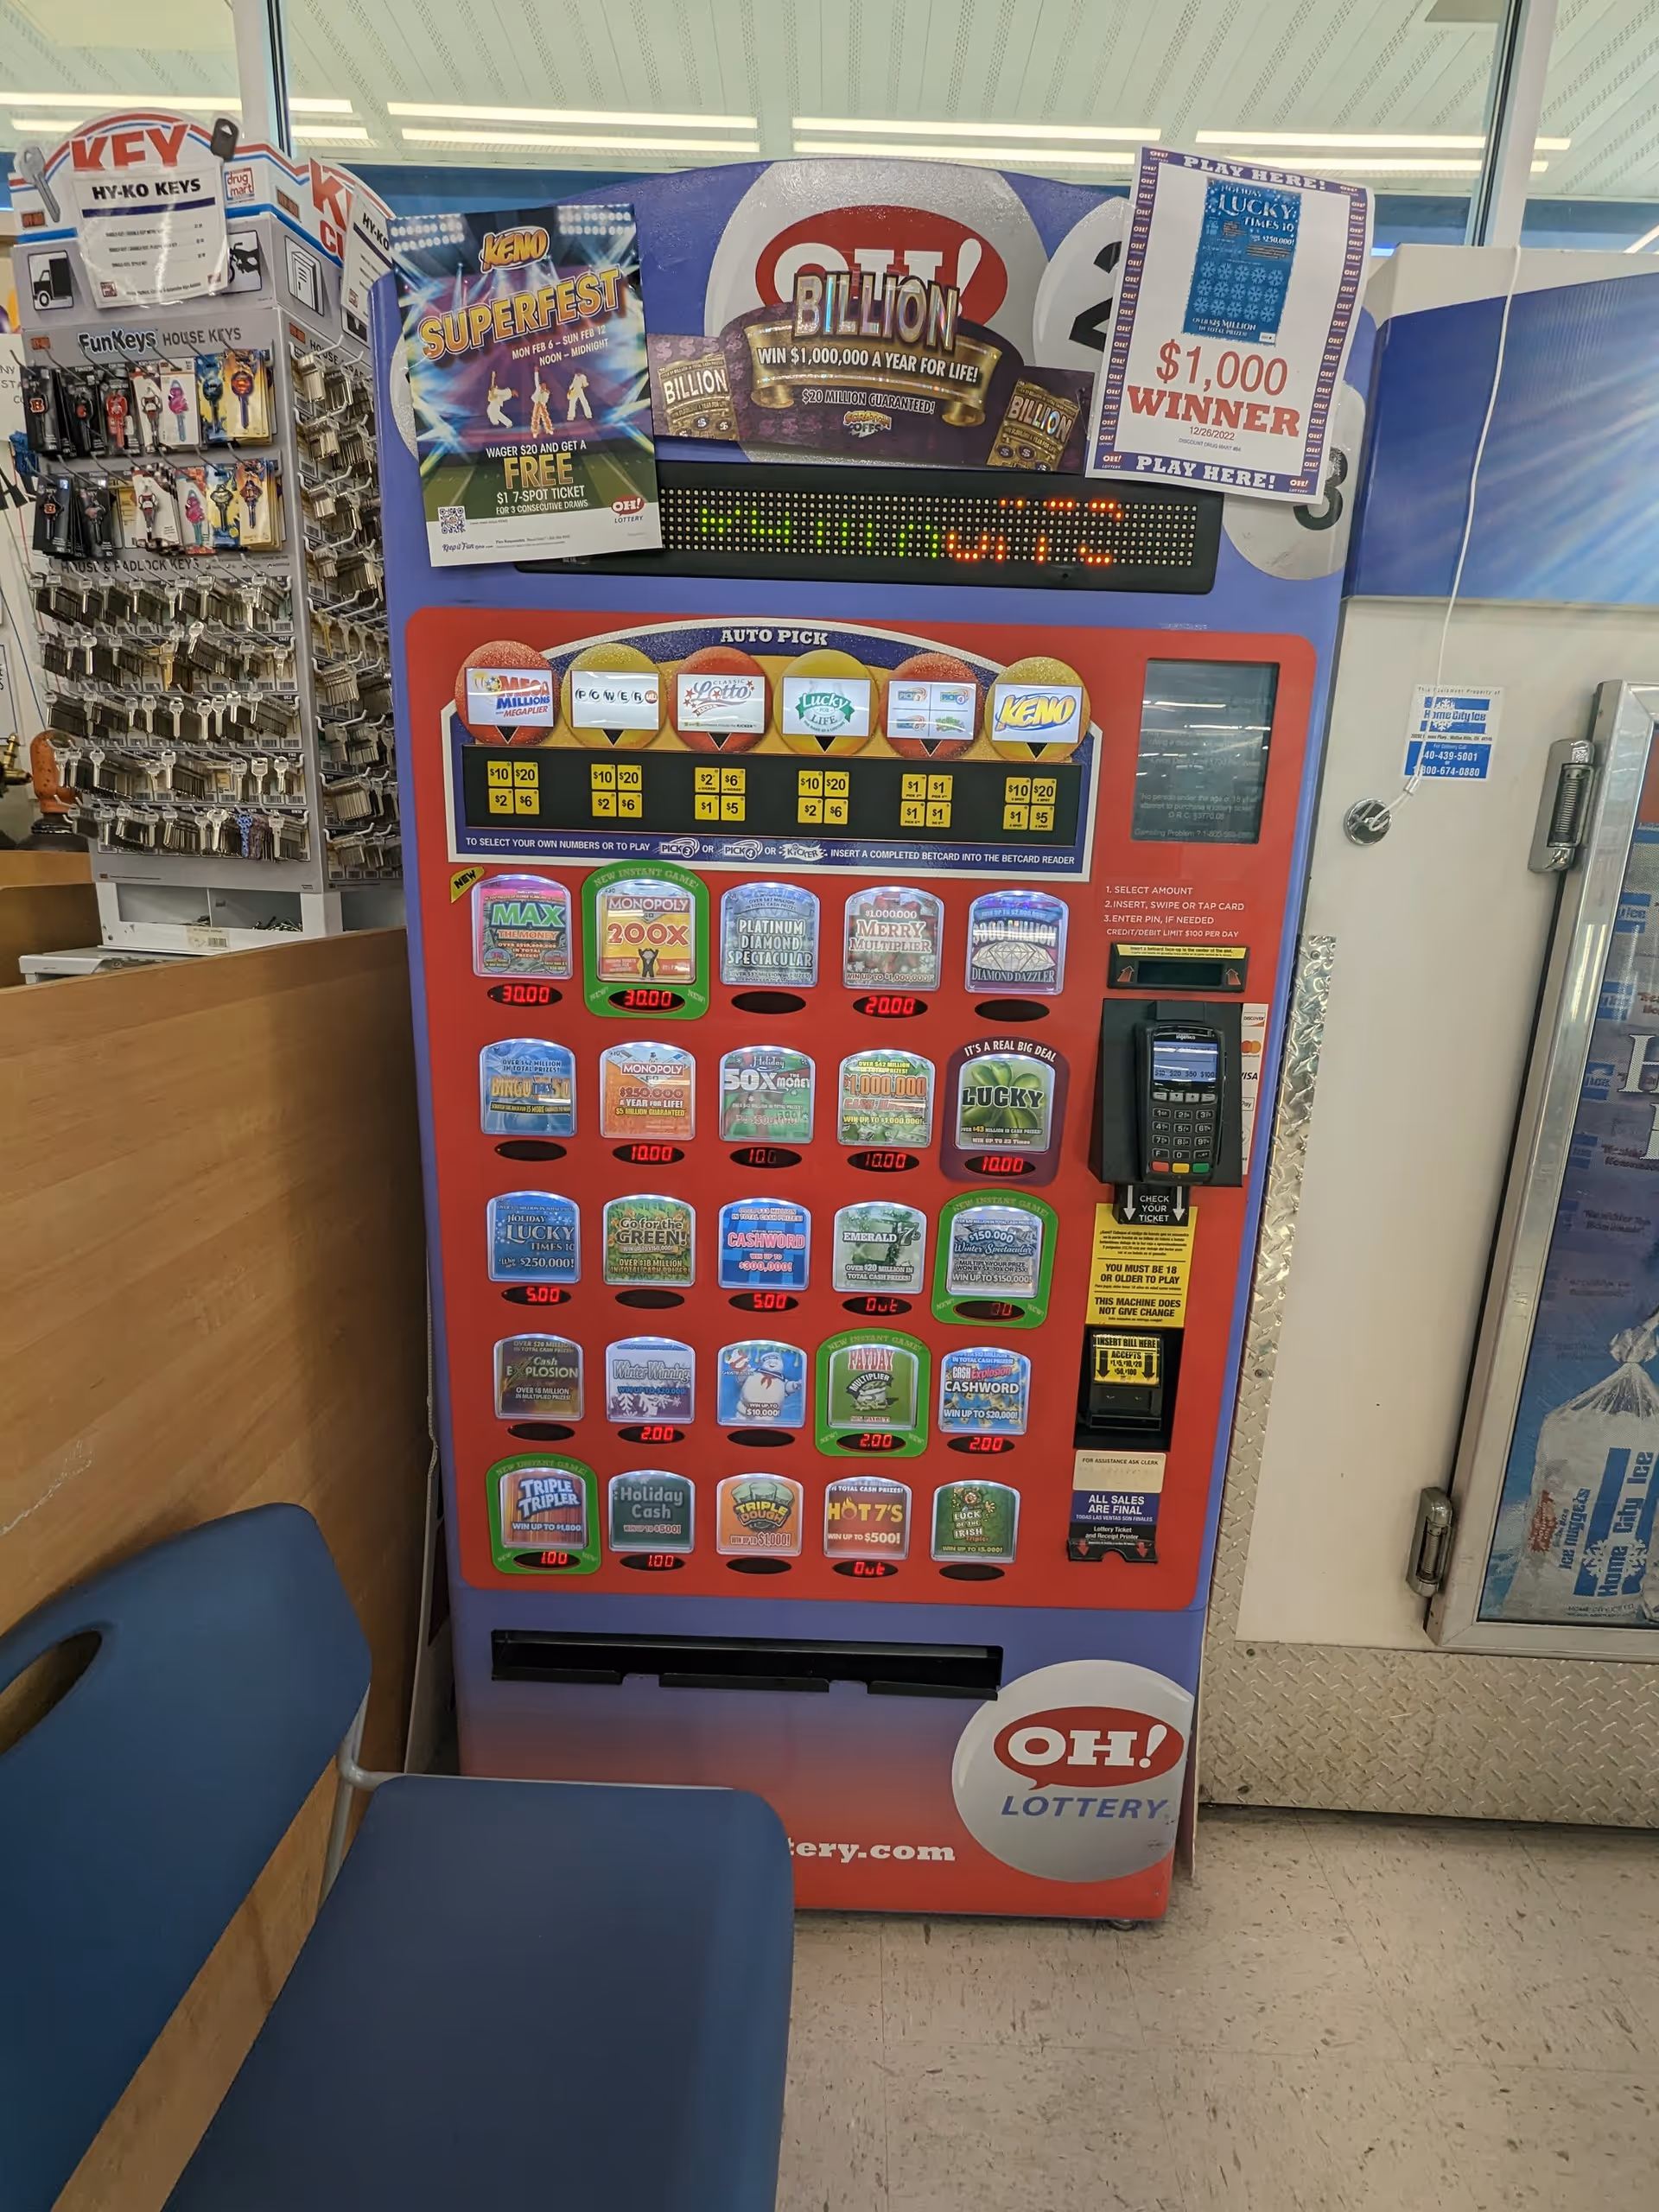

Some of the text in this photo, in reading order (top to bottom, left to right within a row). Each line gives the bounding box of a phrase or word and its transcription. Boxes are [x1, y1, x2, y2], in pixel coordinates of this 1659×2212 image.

[70, 124, 191, 171] KEY
[227, 171, 249, 185] drug
[1184, 156, 1326, 191] PLAY HERE!
[92, 178, 200, 200] HY-KO KEYS
[231, 184, 252, 196] mart
[1218, 194, 1294, 220] LUCKY
[1243, 216, 1294, 232] TIMES 10
[481, 228, 548, 272] KENO
[418, 264, 622, 363] SUPERFEST
[793, 272, 959, 352] BILLION
[78, 327, 158, 355] FunKeys
[162, 327, 242, 347] HOUSE KEYS
[512, 324, 607, 360] MON FEB 6 SUN FEB 12
[539, 339, 609, 366] NOON MIDNIGHT
[757, 346, 979, 383] WIN $1,000,000 A YEAR FOR LIFE!
[1156, 339, 1288, 396] $1,000
[663, 369, 728, 405] BILLION
[802, 389, 936, 414] $20 MILLION GUARANTEED!
[1007, 396, 1071, 443] BILLION
[1127, 385, 1301, 437] WINNER
[1189, 426, 1235, 441] 12/26/2022
[486, 440, 587, 458] WAGER $20 AND GET A
[503, 453, 574, 489] FREE
[1136, 455, 1276, 489] PLAY HERE!
[497, 485, 585, 505] $1 7-SPOT TICKET
[496, 506, 510, 515] FOR
[518, 501, 563, 513] CONSECUTIVE
[564, 499, 588, 510] DRAWS
[612, 497, 641, 512] OH!
[614, 515, 644, 524] LOTTERY
[720, 628, 829, 647] AUTO PICK
[693, 680, 752, 700] Lotto
[496, 696, 550, 709] MILLIONS
[802, 692, 849, 711] Lucky
[503, 705, 549, 717] MEGAPLIER
[810, 715, 837, 725] LIFE
[995, 694, 1076, 731] KENO
[1452, 710, 1486, 721] City Ice
[490, 768, 535, 780] $10 $20
[495, 795, 532, 807] $2 $6
[466, 837, 650, 852] TO SELECT YOUR OWN NUMBERS OR TO PLAY
[830, 849, 1075, 865] INSERT A COMPLETED BETCARD INTO THE BETCARD READER
[453, 869, 476, 889] NEW
[1115, 886, 1193, 895] SELECT AMOUNT
[608, 898, 689, 911] MONOPOLY
[492, 902, 565, 927] MAX
[607, 923, 690, 946] 200X
[739, 918, 805, 935] PLATINUM
[856, 920, 926, 938] MERRY
[741, 936, 802, 950] DIAMOND
[849, 938, 931, 952] MULTIPLIER
[728, 951, 813, 967] SPECTACULAR
[972, 968, 1055, 982] DIAMOND DAZZLER
[503, 985, 550, 1002] 30.00
[866, 996, 915, 1014] 20.00
[964, 1040, 1057, 1062] IT'S A REAL BIG DEAL
[623, 1064, 683, 1075] MONOPOLY
[724, 1069, 777, 1091] 50X
[963, 1085, 1044, 1109] LUCKY
[632, 1146, 672, 1160] 10.00
[1139, 1214, 1169, 1223] TICKET
[506, 1224, 575, 1242] LUCKY
[617, 1230, 689, 1246] GREEN!
[728, 1232, 805, 1249] CASHWORD
[842, 1231, 898, 1243] EMERALD
[954, 1242, 1033, 1255] Winter Spectacular
[520, 1257, 575, 1268] $250,000!
[1125, 1264, 1149, 1273] MUST
[1095, 1297, 1114, 1306] THIS
[1116, 1298, 1156, 1306] MACHINE
[848, 1349, 895, 1371] PAYDAY
[849, 1373, 891, 1391] MULTIPLIER
[945, 1381, 1019, 1394] CASHWORD
[519, 1478, 574, 1497] TRIPLE
[518, 1493, 581, 1519] TRIPLER
[620, 1486, 683, 1508] Holiday
[1089, 1495, 1144, 1504] ALL SALES
[632, 1504, 671, 1519] Cash
[828, 1497, 903, 1522] HOT 7'S
[1089, 1504, 1141, 1515] ARE FINAL
[1007, 1724, 1167, 1769] OH!
[1001, 1796, 1169, 1819] LOTTERY
